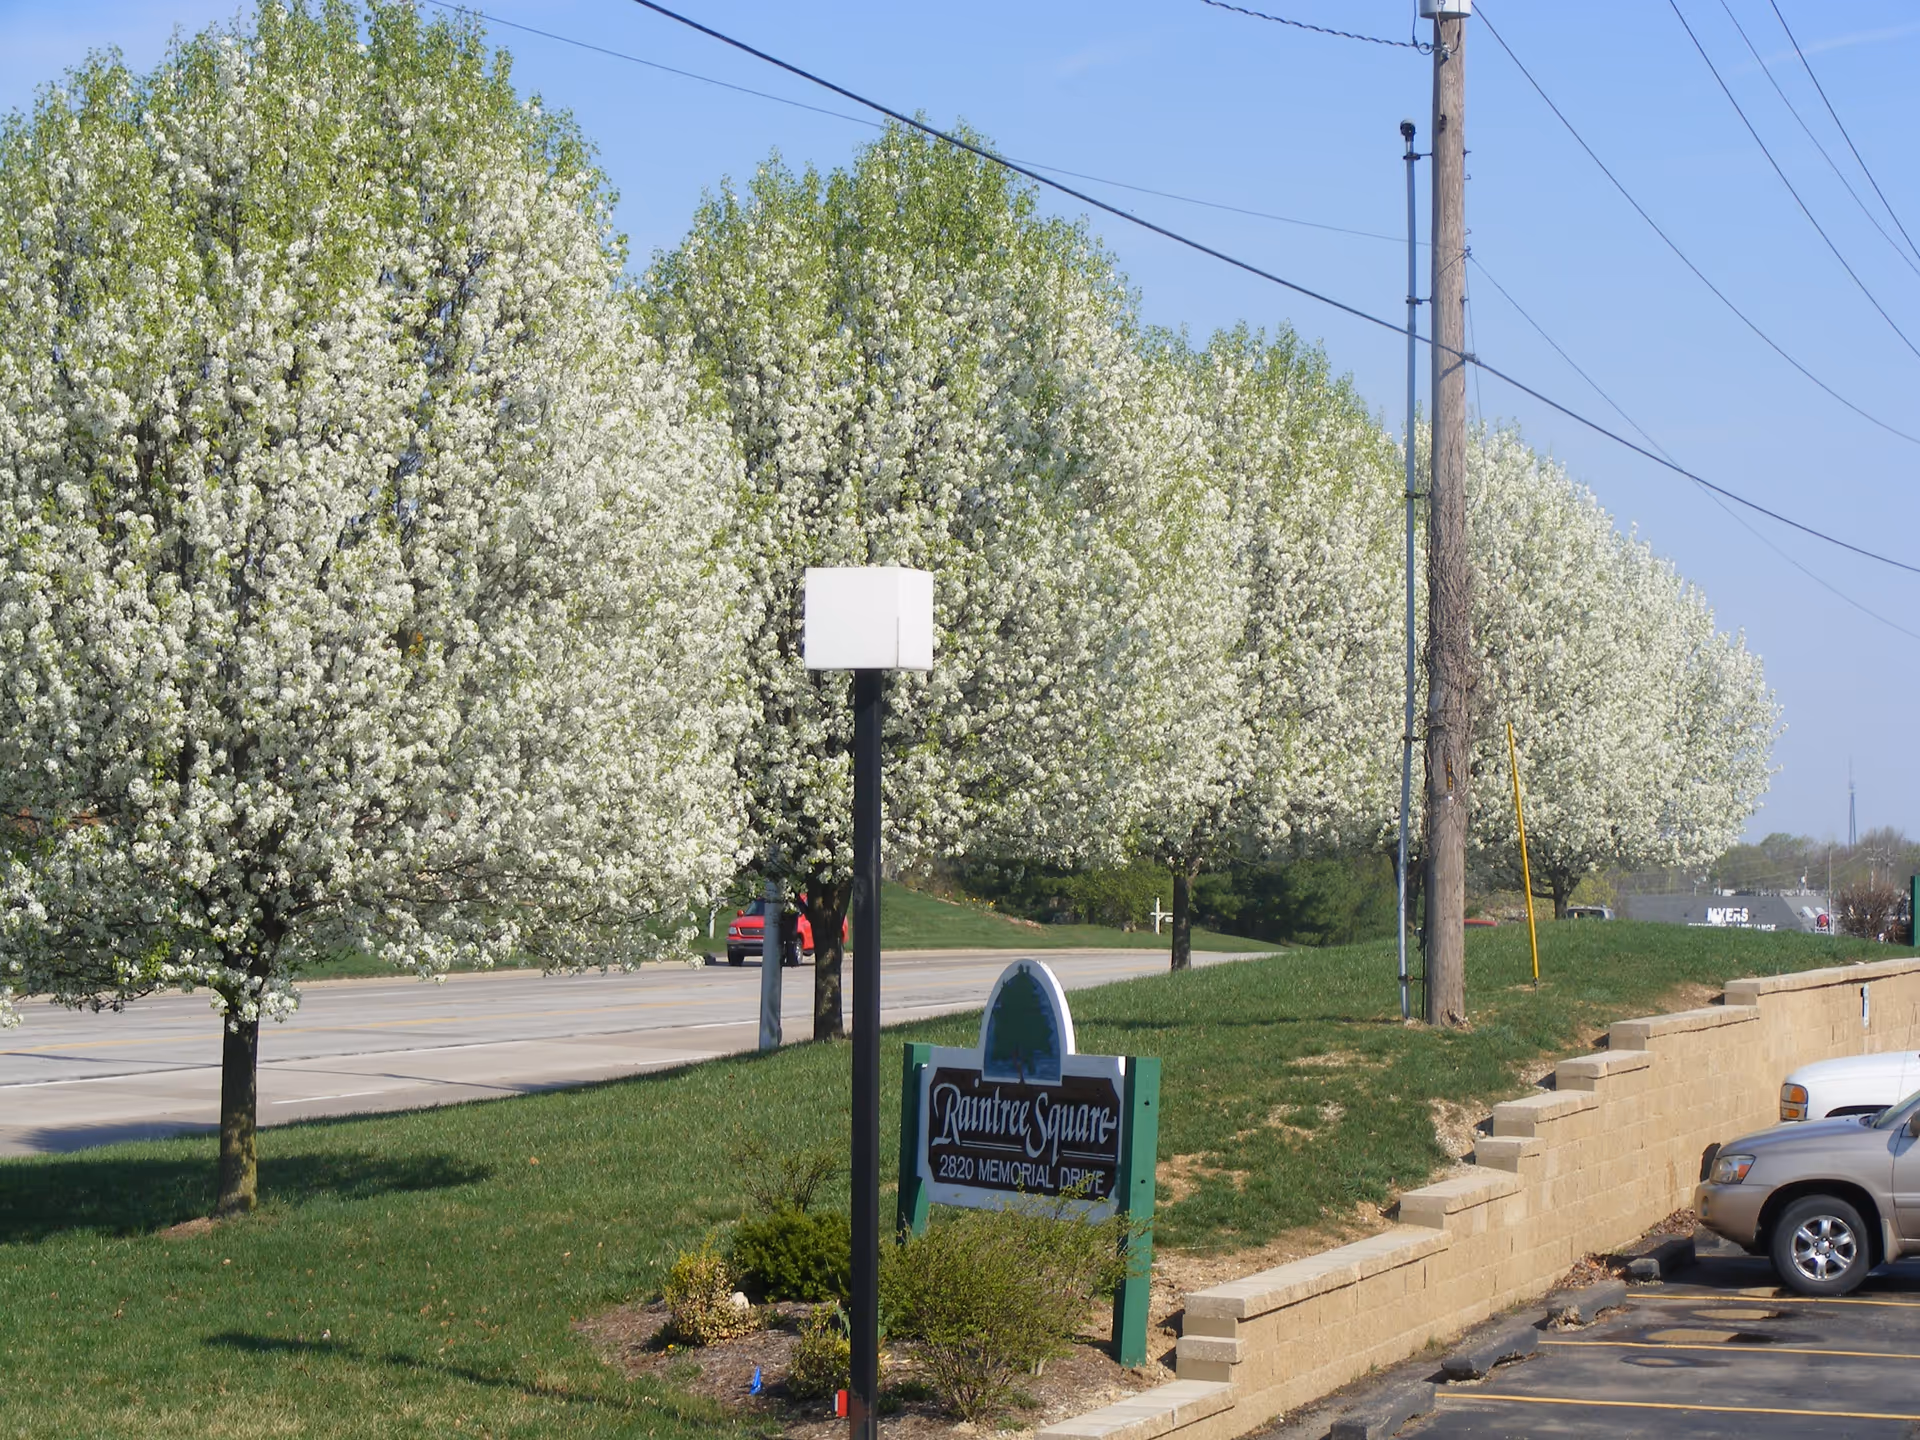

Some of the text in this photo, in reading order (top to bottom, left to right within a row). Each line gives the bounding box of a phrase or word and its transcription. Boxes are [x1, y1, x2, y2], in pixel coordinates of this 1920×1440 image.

[1707, 907, 1749, 923] MYERS
[932, 1078, 1117, 1166] Raintree Square
[939, 1154, 1106, 1195] 2820 MEMORIAL DRIVE
